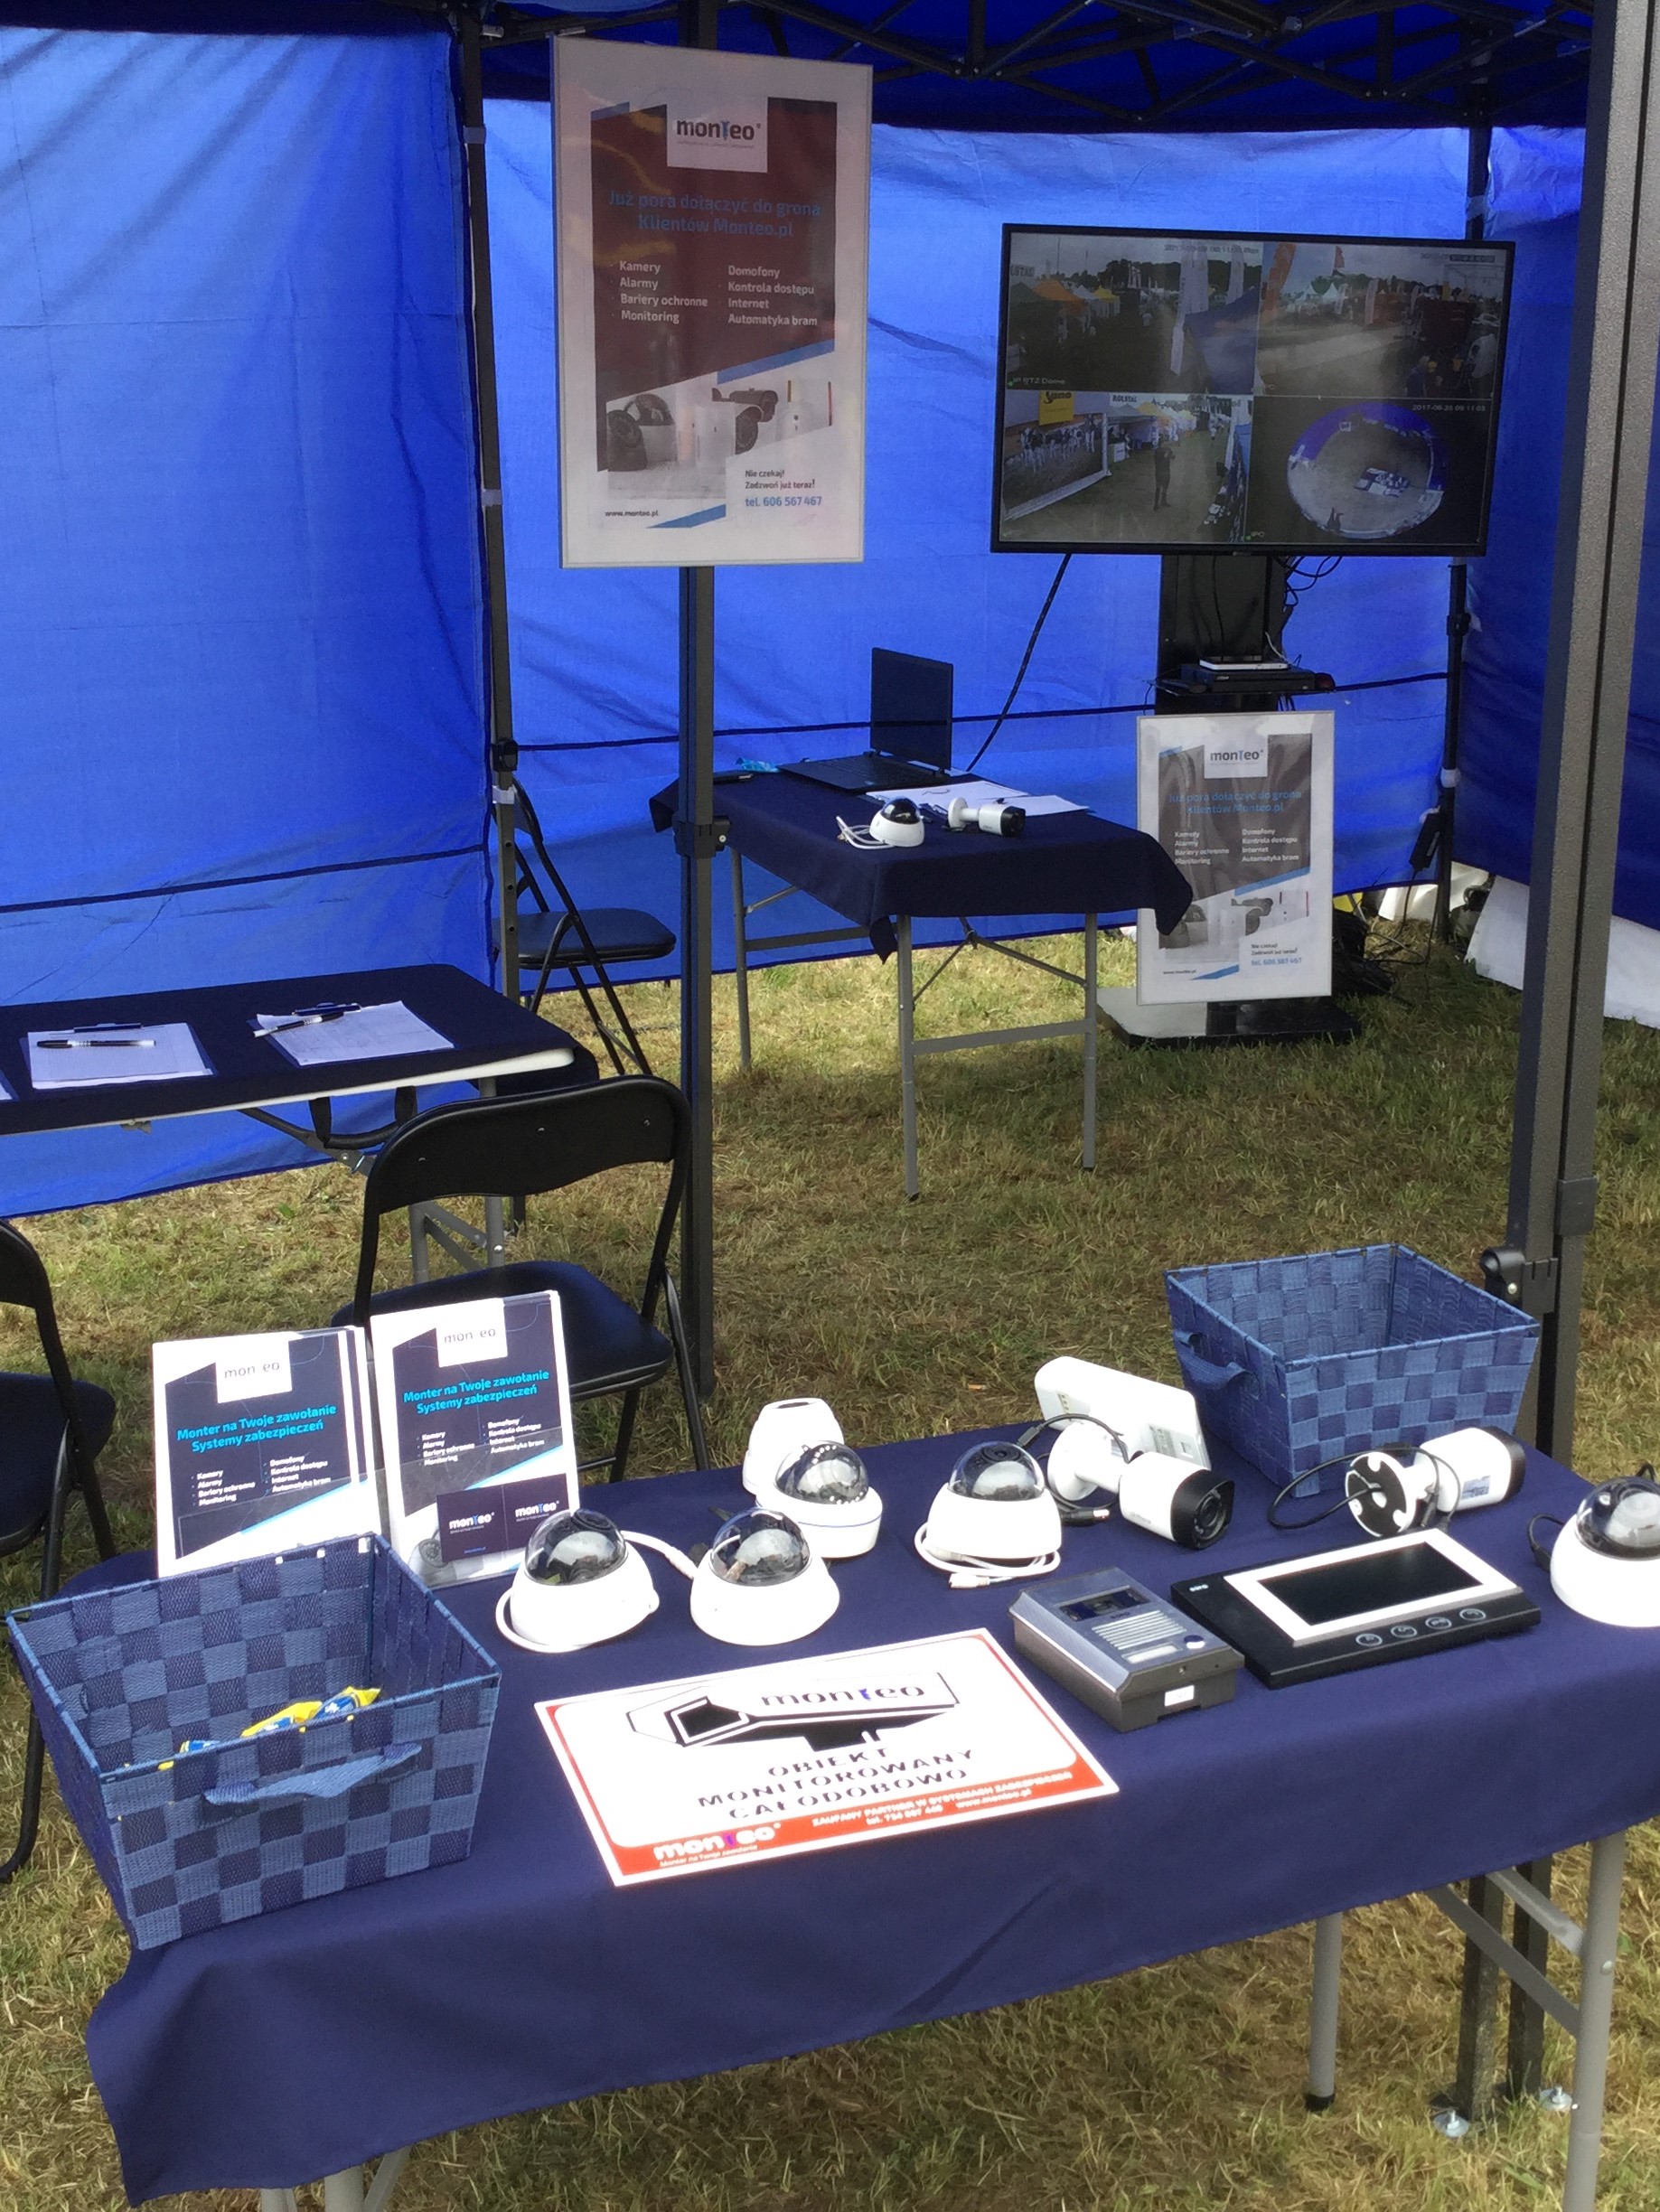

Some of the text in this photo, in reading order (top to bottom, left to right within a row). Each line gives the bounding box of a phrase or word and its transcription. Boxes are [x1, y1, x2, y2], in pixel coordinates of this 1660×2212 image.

[609, 191, 633, 207] Już
[639, 195, 677, 210] pora
[753, 199, 773, 213] do
[777, 202, 821, 217] grona
[638, 214, 708, 231] Klientów
[620, 260, 780, 279] Kamery Domofony
[620, 277, 814, 295] Alarmy Kontrola dostępu
[621, 294, 769, 308] Bariery ochronne Internet
[621, 310, 817, 326] Monitoring Automatyka bram
[759, 470, 784, 479] czekaj!
[780, 482, 792, 491] już
[793, 479, 815, 489] teraz!
[746, 496, 821, 507] tel. 606 567 467
[444, 1328, 496, 1344] moneo
[224, 1361, 280, 1379] moneo
[403, 1369, 549, 1403] Monter na Twoje zawołanie
[416, 1384, 537, 1415] Systemy zabezpieczeń
[177, 1404, 337, 1441] Monter na Twoje zawołanie
[192, 1420, 324, 1454] Systemy zabezpieczeń
[768, 1748, 887, 1776] OBIEKT
[699, 1749, 971, 1807] MONITOROWANY
[729, 1769, 966, 1819] CAŁODOBOWO
